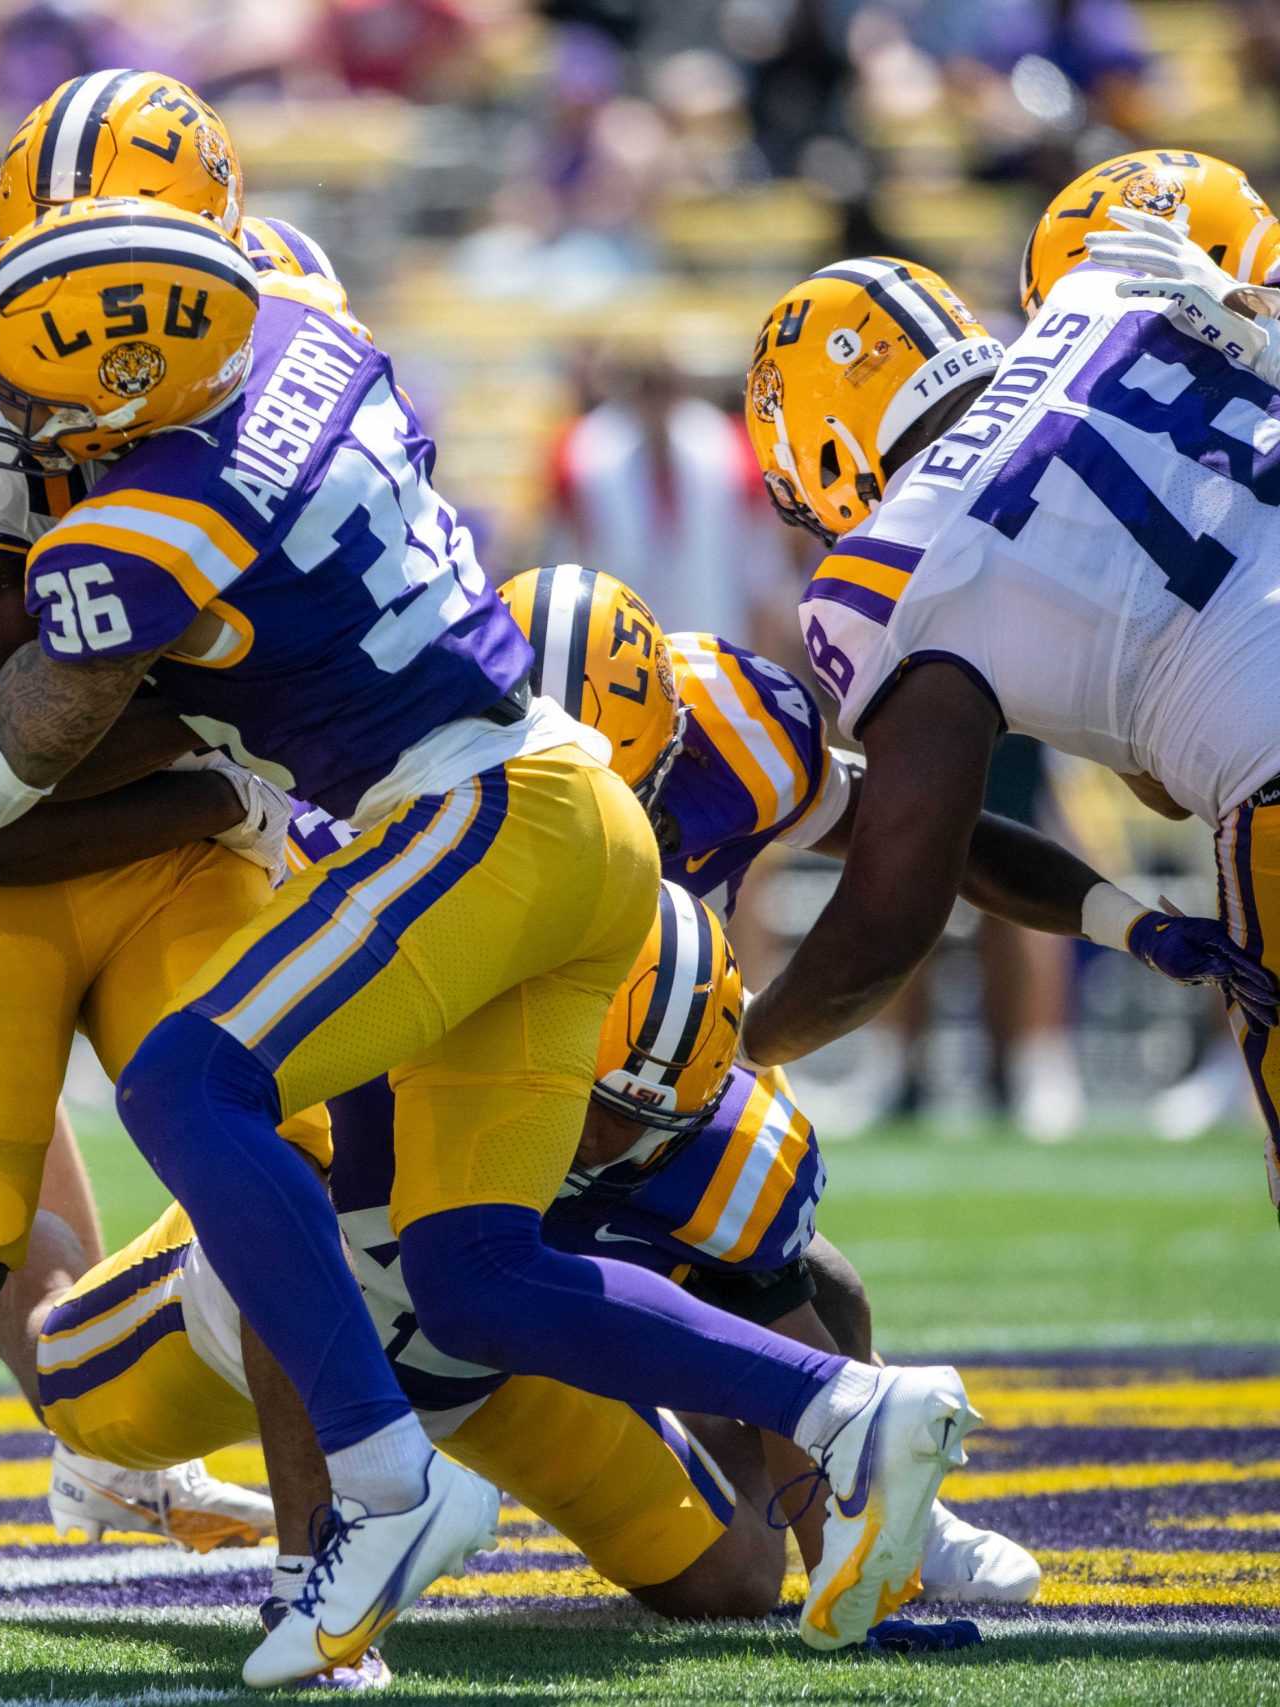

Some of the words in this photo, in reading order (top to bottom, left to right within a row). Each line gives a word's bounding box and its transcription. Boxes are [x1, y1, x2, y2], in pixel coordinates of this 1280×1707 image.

[1057, 153, 1201, 219] LSU
[41, 284, 212, 358] LSU
[833, 334, 855, 358] 3
[913, 343, 1004, 398] TIGERS
[919, 312, 1090, 481] ECHOLS
[220, 316, 363, 523] AUSBERRY
[967, 310, 1280, 613] 78
[35, 562, 132, 654] 36
[623, 1082, 667, 1107] LSU
[53, 1477, 84, 1503] LSU
